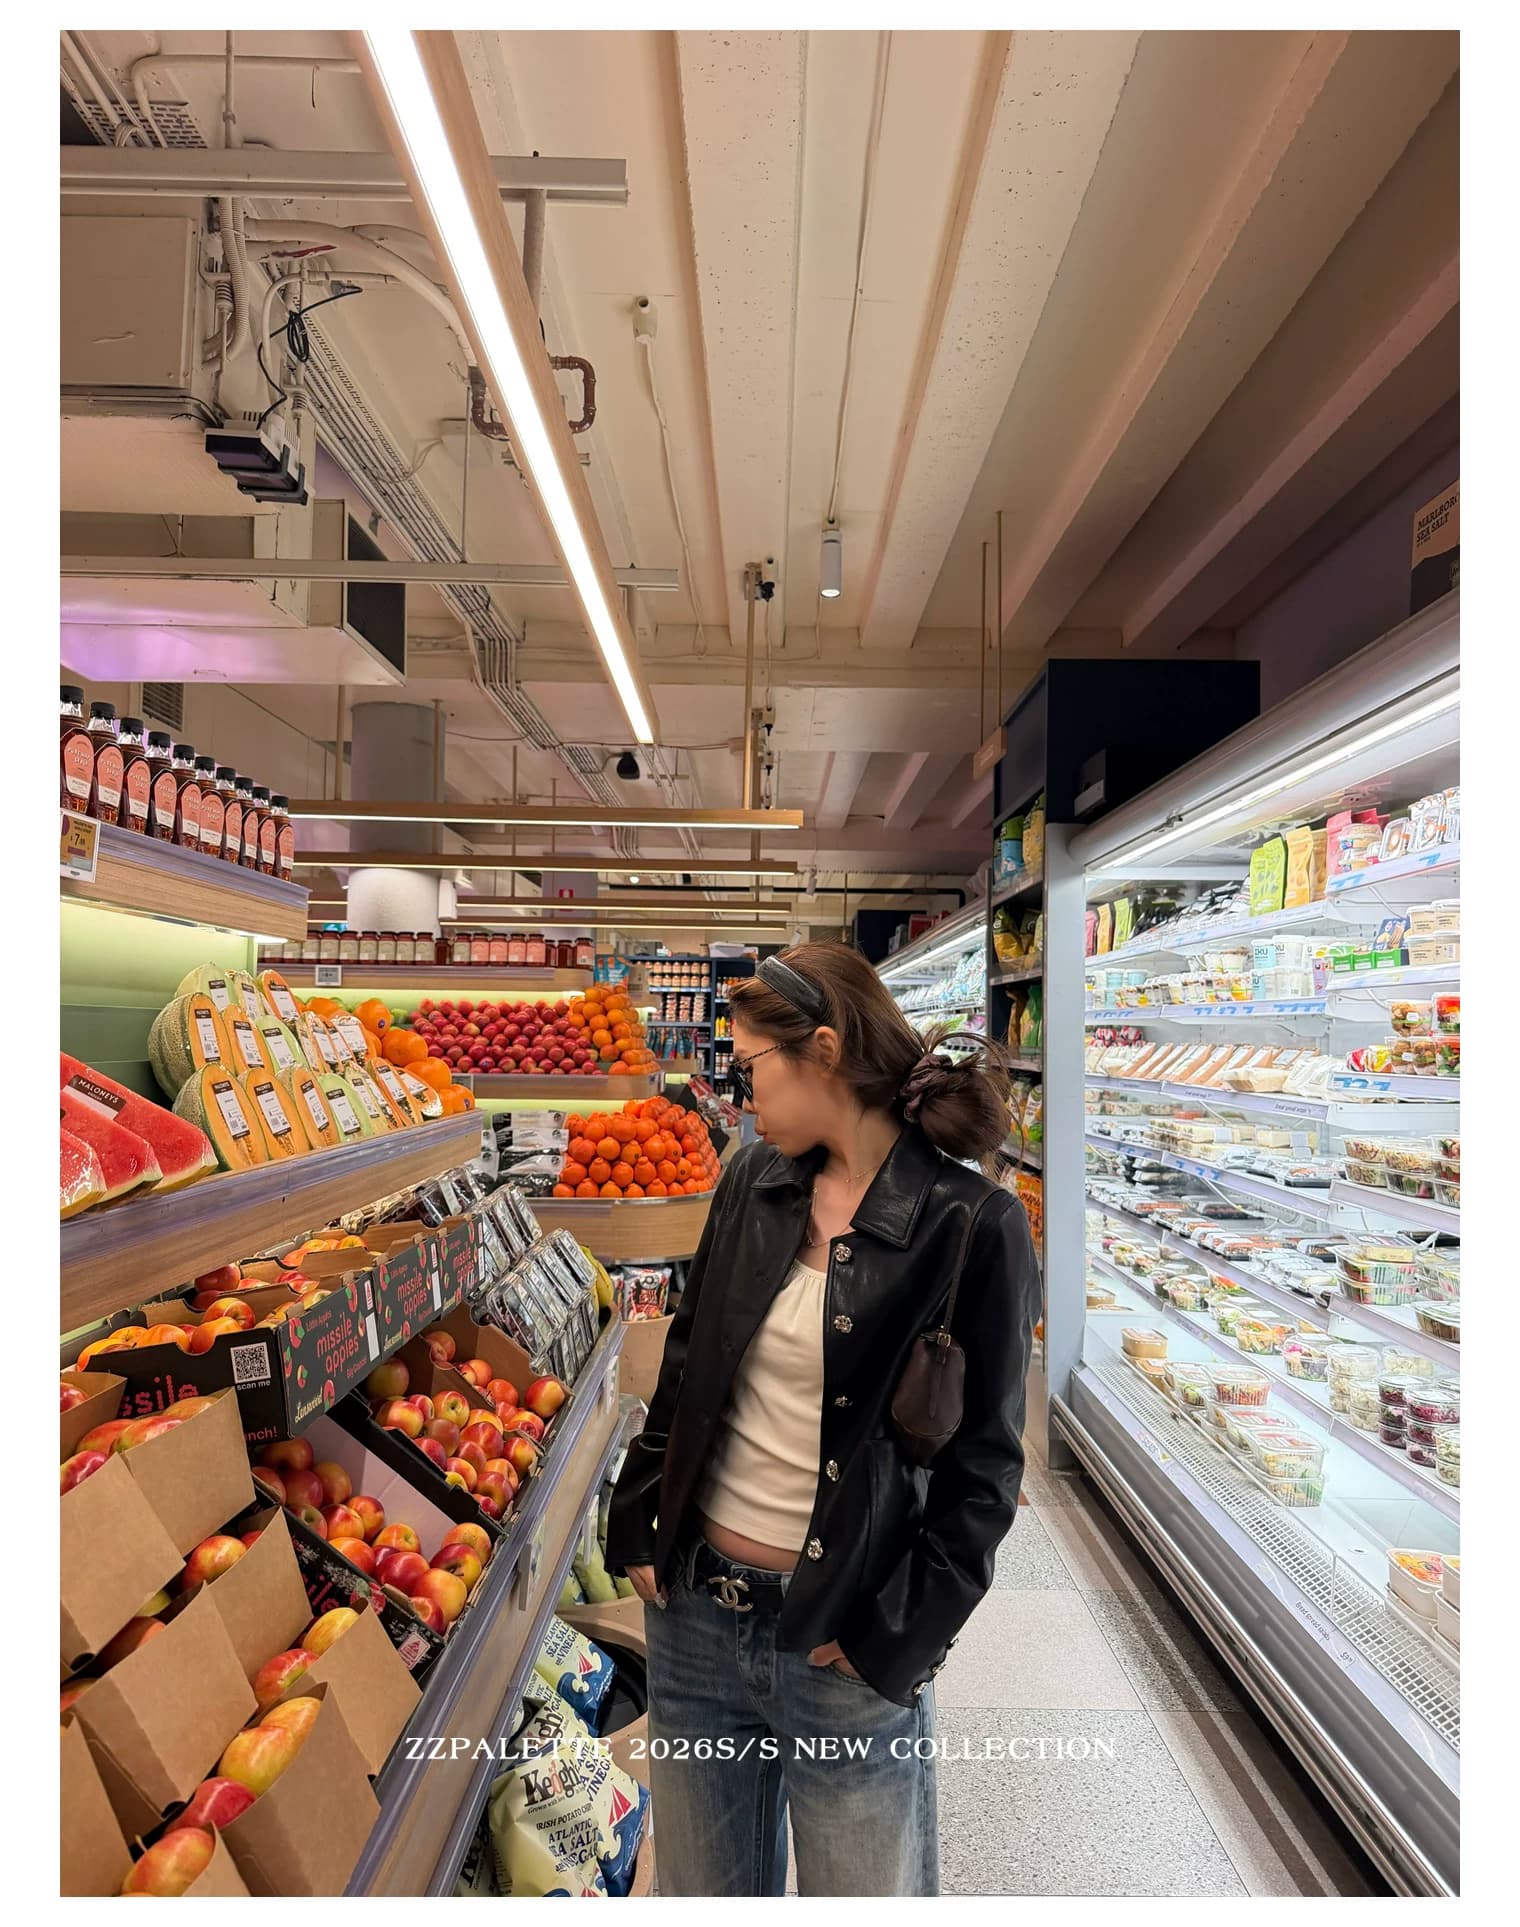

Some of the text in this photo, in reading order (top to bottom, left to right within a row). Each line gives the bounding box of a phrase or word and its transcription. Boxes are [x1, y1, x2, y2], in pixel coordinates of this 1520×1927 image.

[1416, 526, 1430, 543] SEA
[1431, 512, 1449, 533] SALT
[78, 1079, 119, 1103] MALONEYS
[397, 1266, 423, 1302] missile
[403, 1287, 428, 1320] apples
[316, 1311, 353, 1358] missile
[325, 1335, 359, 1378] apples
[119, 1375, 200, 1417] ssile
[236, 1379, 271, 1391] scan me
[546, 1625, 570, 1657] SEA SAL
[557, 1630, 579, 1657] VINEGA
[548, 1817, 593, 1845] ATLANTIC
[556, 1807, 581, 1824] POTATO
[569, 1826, 599, 1852] SALT
